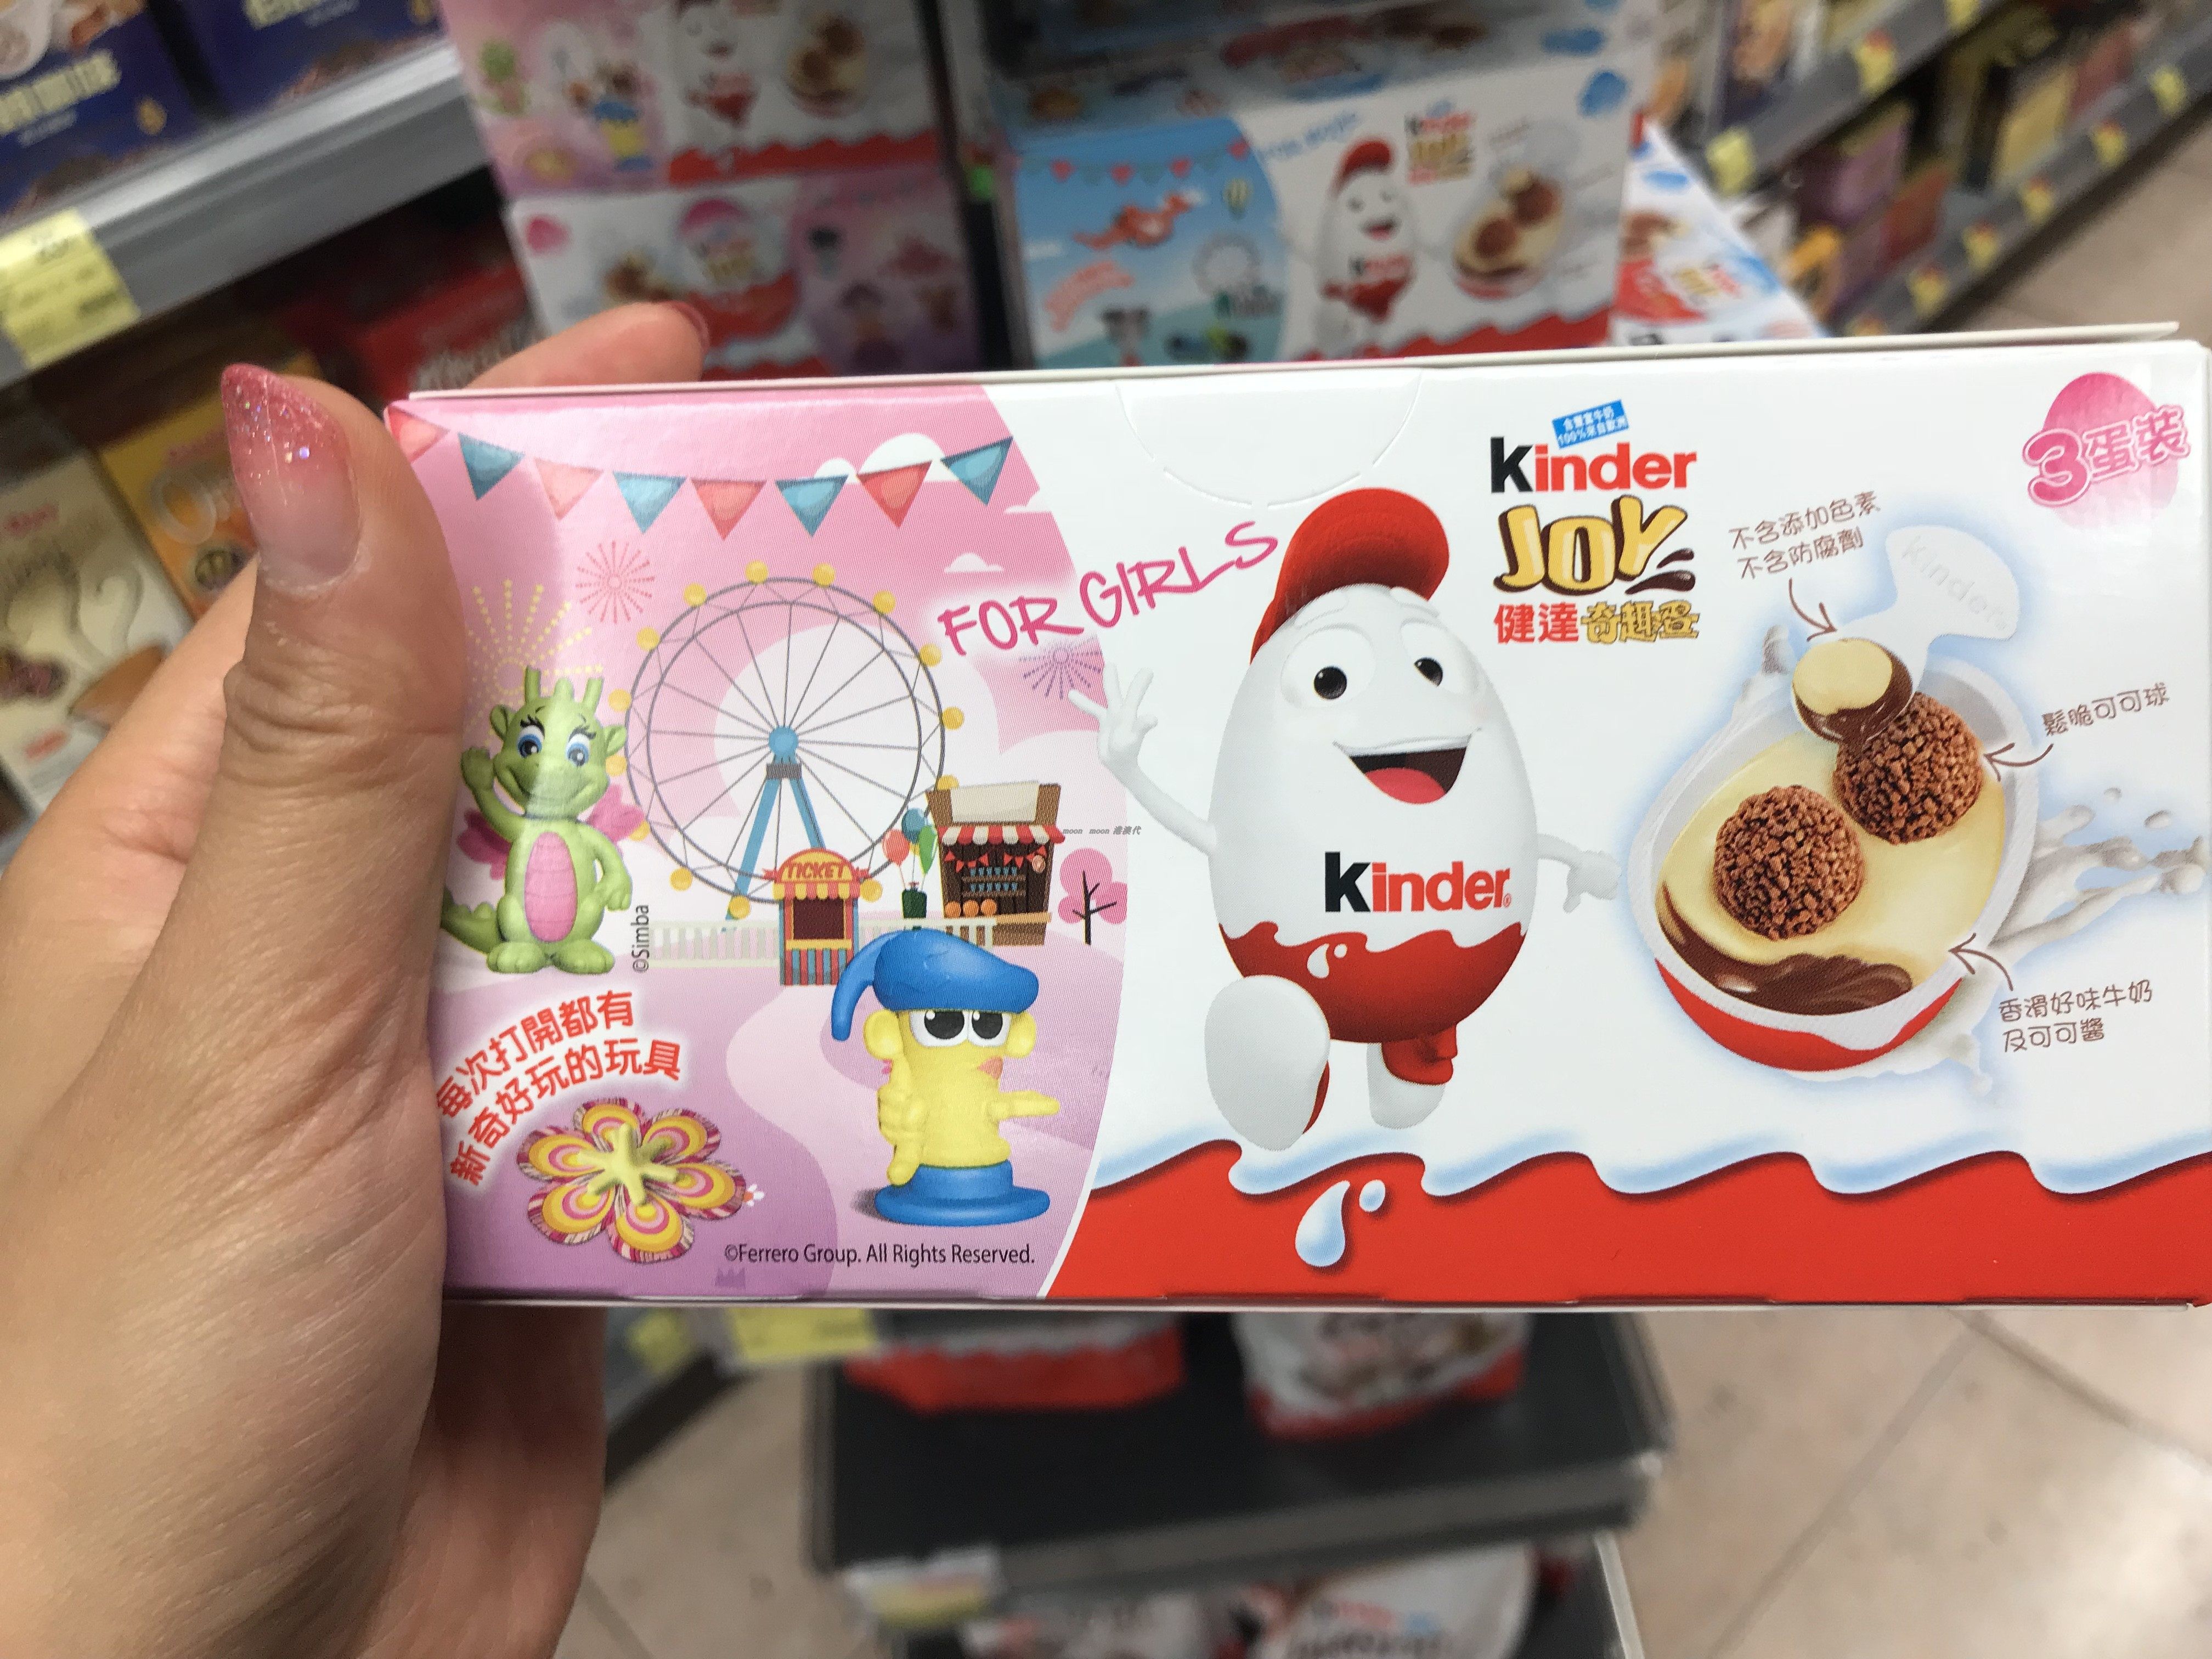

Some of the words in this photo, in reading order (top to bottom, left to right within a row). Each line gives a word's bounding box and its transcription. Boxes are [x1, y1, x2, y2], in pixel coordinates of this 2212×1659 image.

[2022, 404, 2191, 507] 3蛋裝
[1493, 494, 1689, 596] JOY
[1728, 490, 1881, 550] 不含添加色素
[937, 595, 1085, 656] FOR
[1079, 520, 1279, 629] GIRLS
[1493, 599, 1701, 645] 健達奇趣蛋
[2041, 681, 2170, 737] 鬆脆可可球
[787, 861, 844, 879] TICKET
[1998, 979, 2154, 1023] 香滑好味牛奶
[2002, 1017, 2105, 1053] 及可可醬
[449, 1037, 681, 1186] 新奇好玩的玩具
[803, 1243, 862, 1267] Group.
[866, 1243, 887, 1263] All
[892, 1243, 946, 1268] Rights
[951, 1243, 1036, 1264] Reserved.
